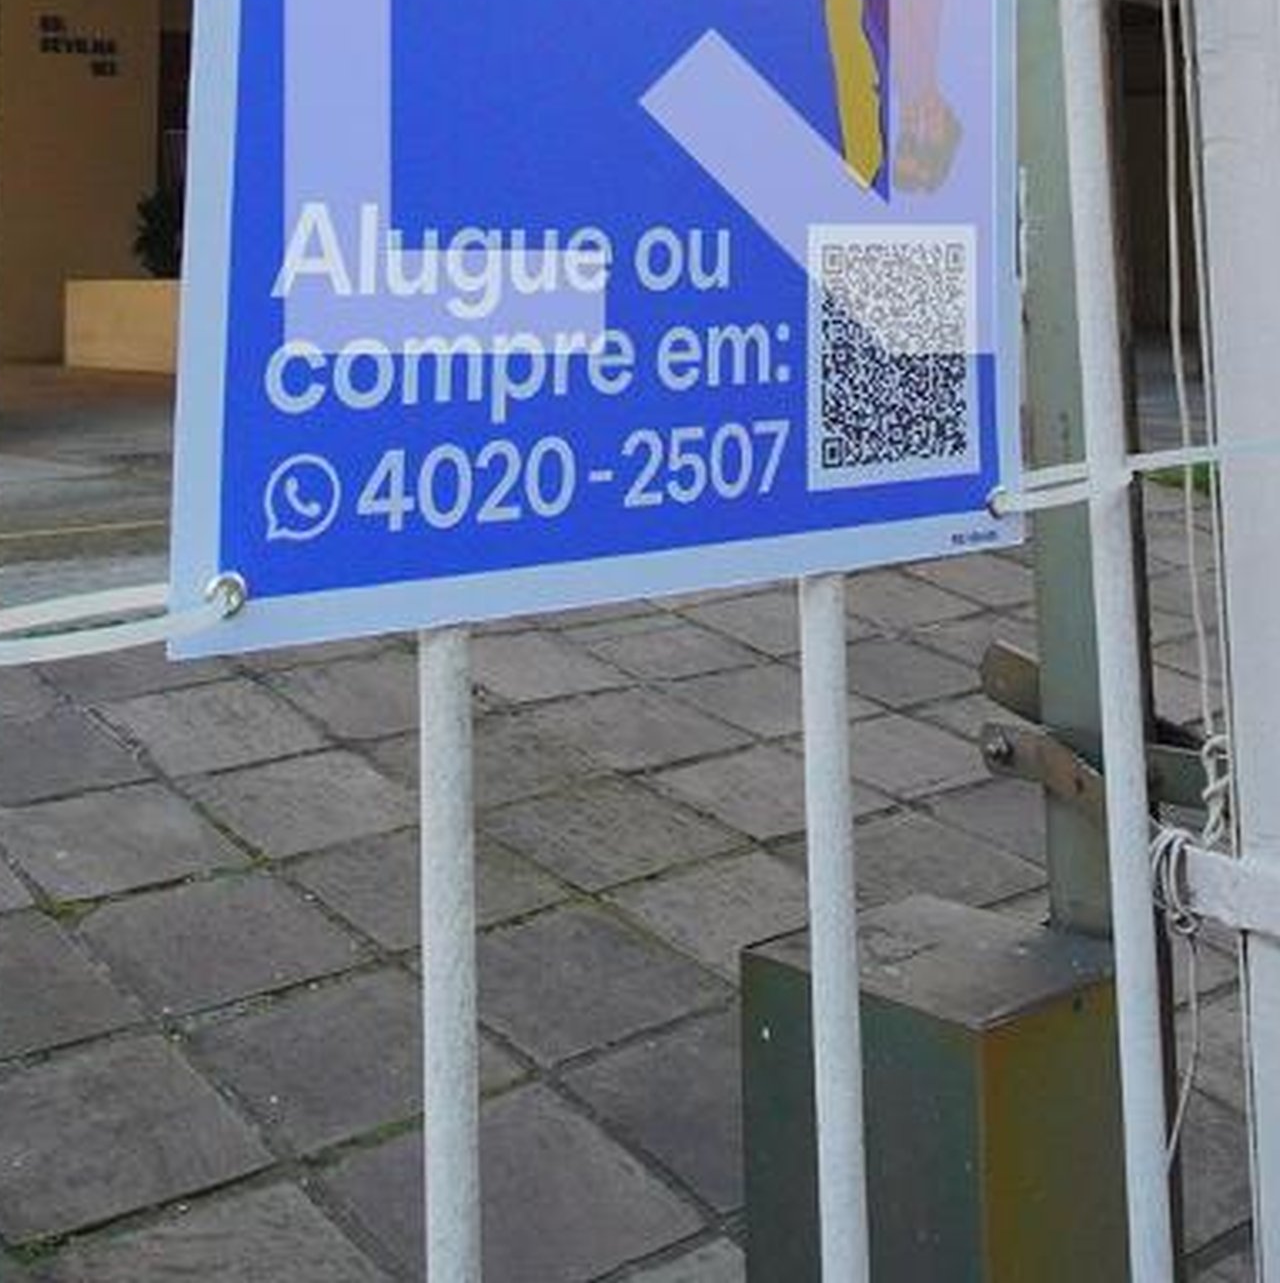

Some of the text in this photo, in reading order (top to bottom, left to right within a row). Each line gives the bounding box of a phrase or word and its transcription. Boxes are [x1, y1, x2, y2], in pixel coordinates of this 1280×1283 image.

[270, 201, 732, 320] Alugue ou
[263, 318, 793, 423] compre em:
